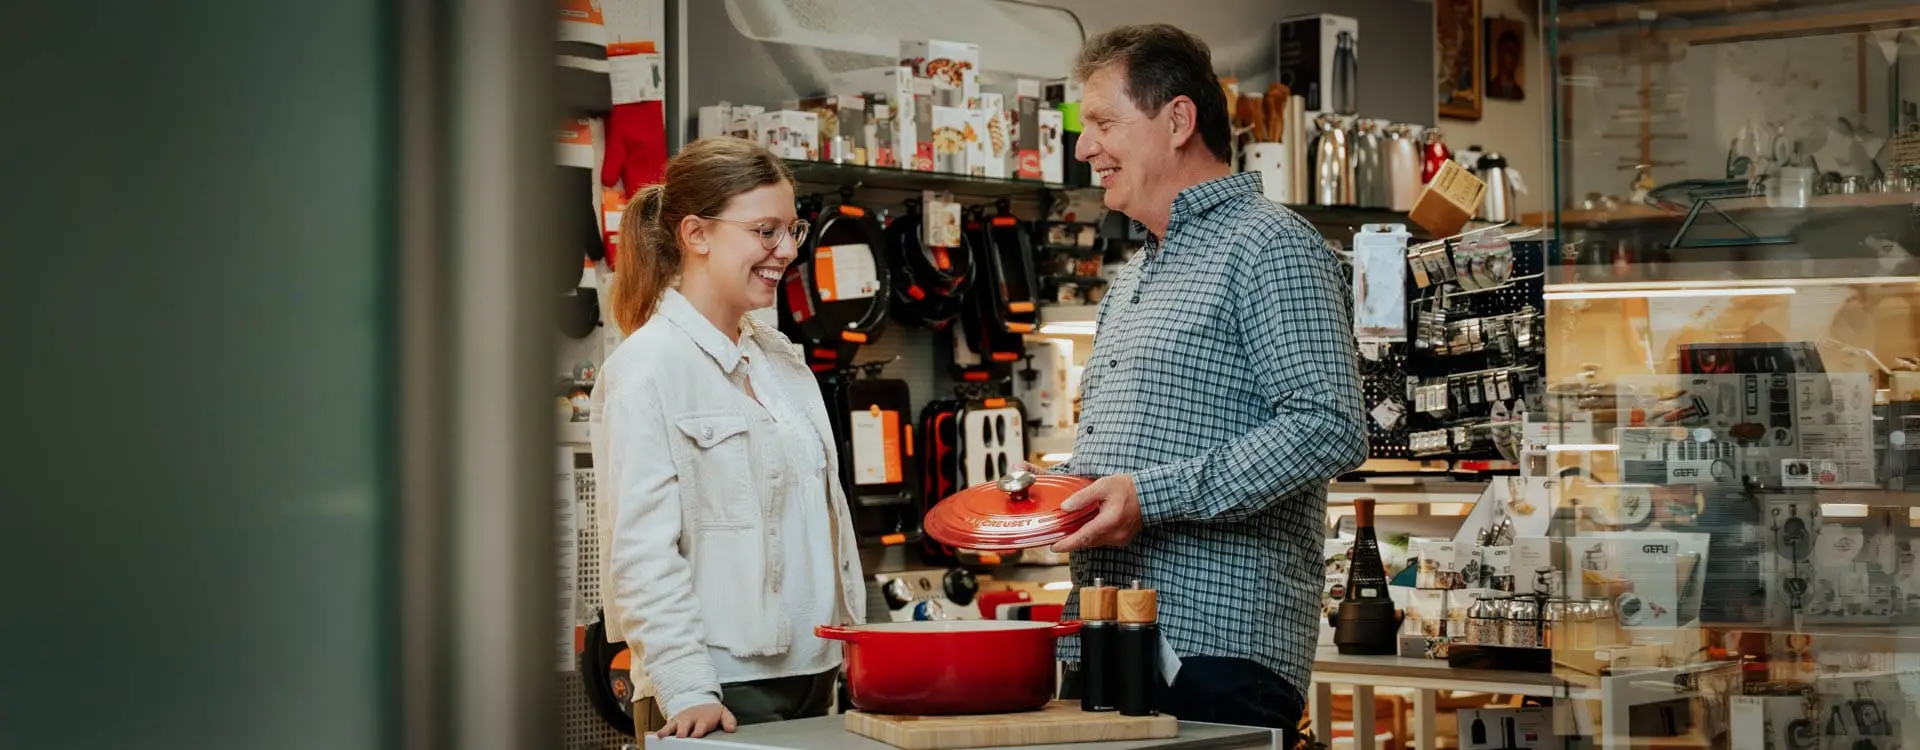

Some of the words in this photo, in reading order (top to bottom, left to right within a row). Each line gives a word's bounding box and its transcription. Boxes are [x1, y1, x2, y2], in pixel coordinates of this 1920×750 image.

[1673, 468, 1699, 477] GEFU
[982, 519, 1032, 527] CREUSET
[1642, 544, 1669, 554] GEFU
